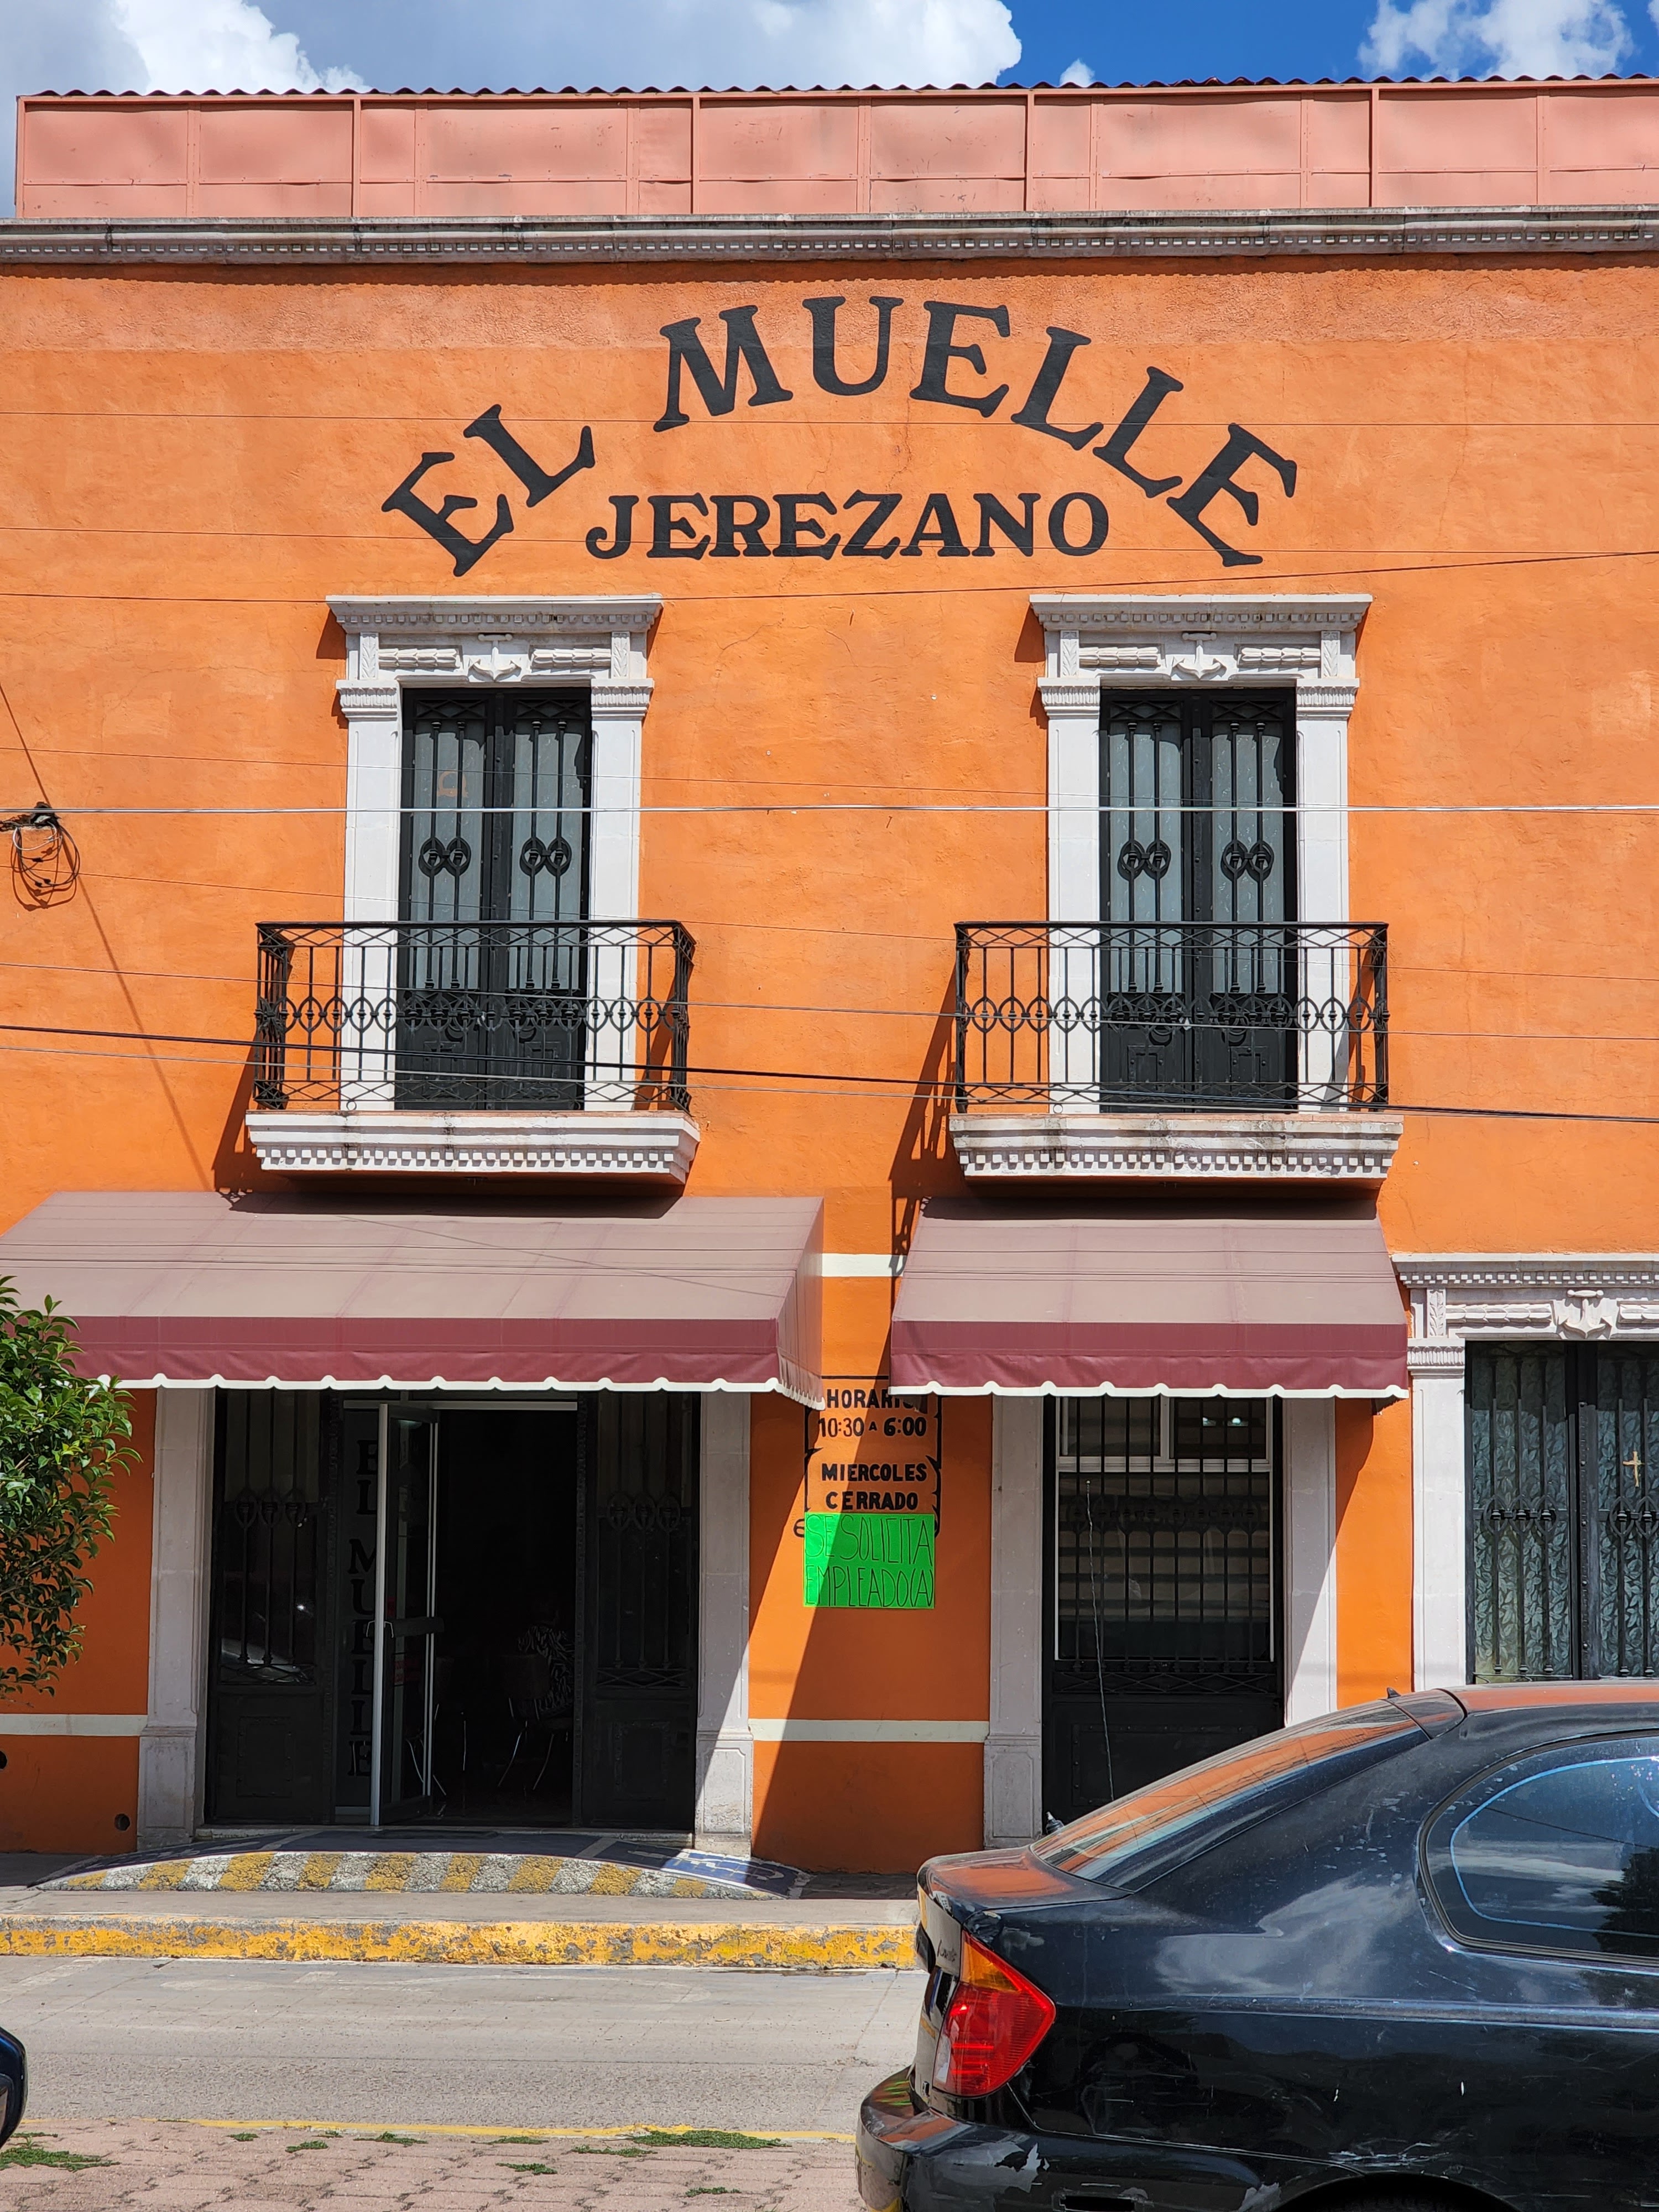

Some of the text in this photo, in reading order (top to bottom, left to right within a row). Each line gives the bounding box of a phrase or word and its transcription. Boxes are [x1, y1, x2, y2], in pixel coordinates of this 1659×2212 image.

[382, 296, 1297, 577] EL MUELLE
[586, 489, 1108, 560] JEREZANO
[818, 1417, 864, 1437] 10:30
[884, 1417, 926, 1437] 6:00
[821, 1463, 927, 1481] MIERCOLES
[826, 1491, 918, 1510] CERRADO
[805, 1514, 933, 1566] SE SOLICITA
[806, 1564, 933, 1607] EMPLEADO(A)
